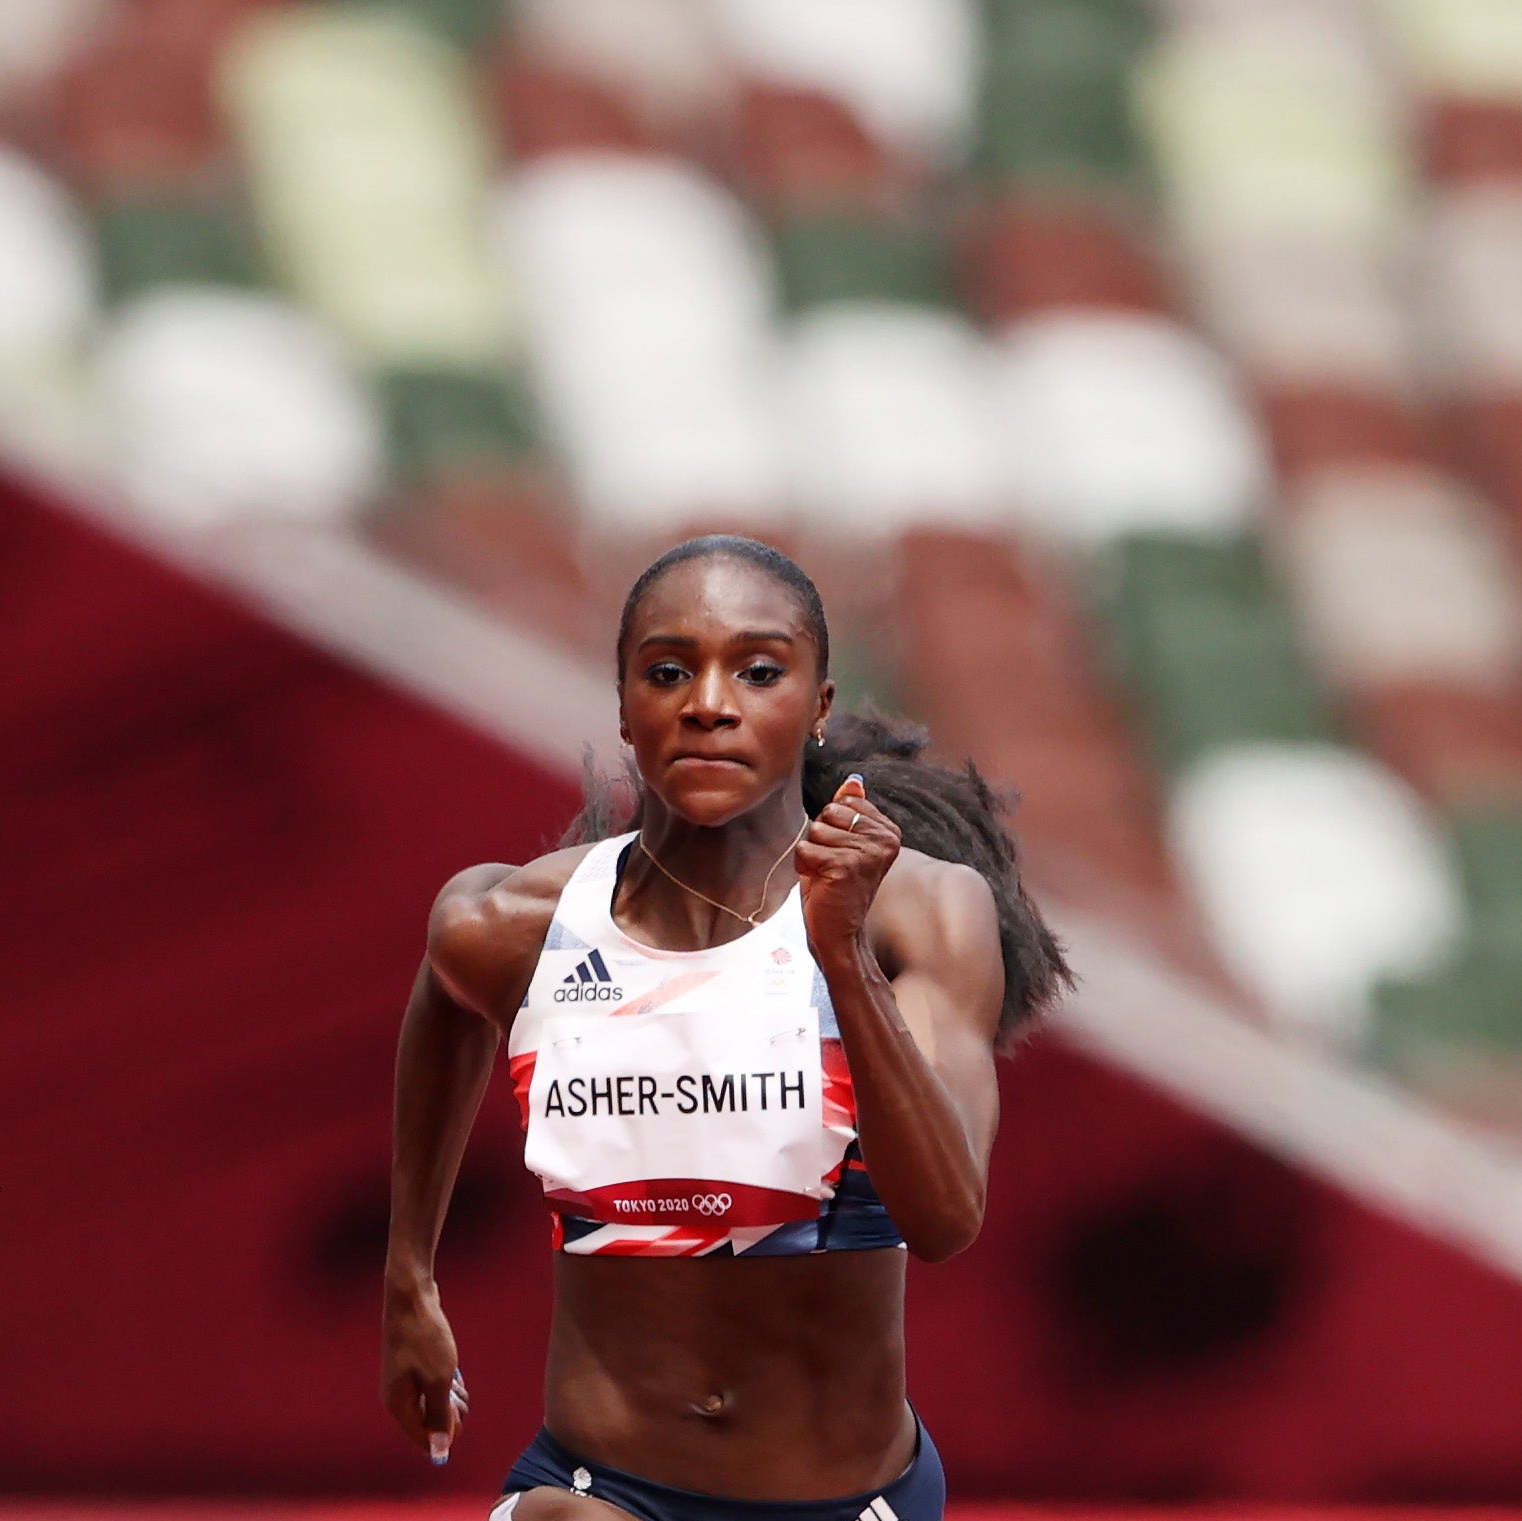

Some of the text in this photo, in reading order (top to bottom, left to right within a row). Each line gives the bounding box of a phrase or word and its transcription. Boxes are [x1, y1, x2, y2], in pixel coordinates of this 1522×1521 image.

[553, 983, 623, 1003] adidas
[544, 1070, 806, 1118] ASHER-SMITH
[613, 1198, 689, 1213] TOKYO 2020
